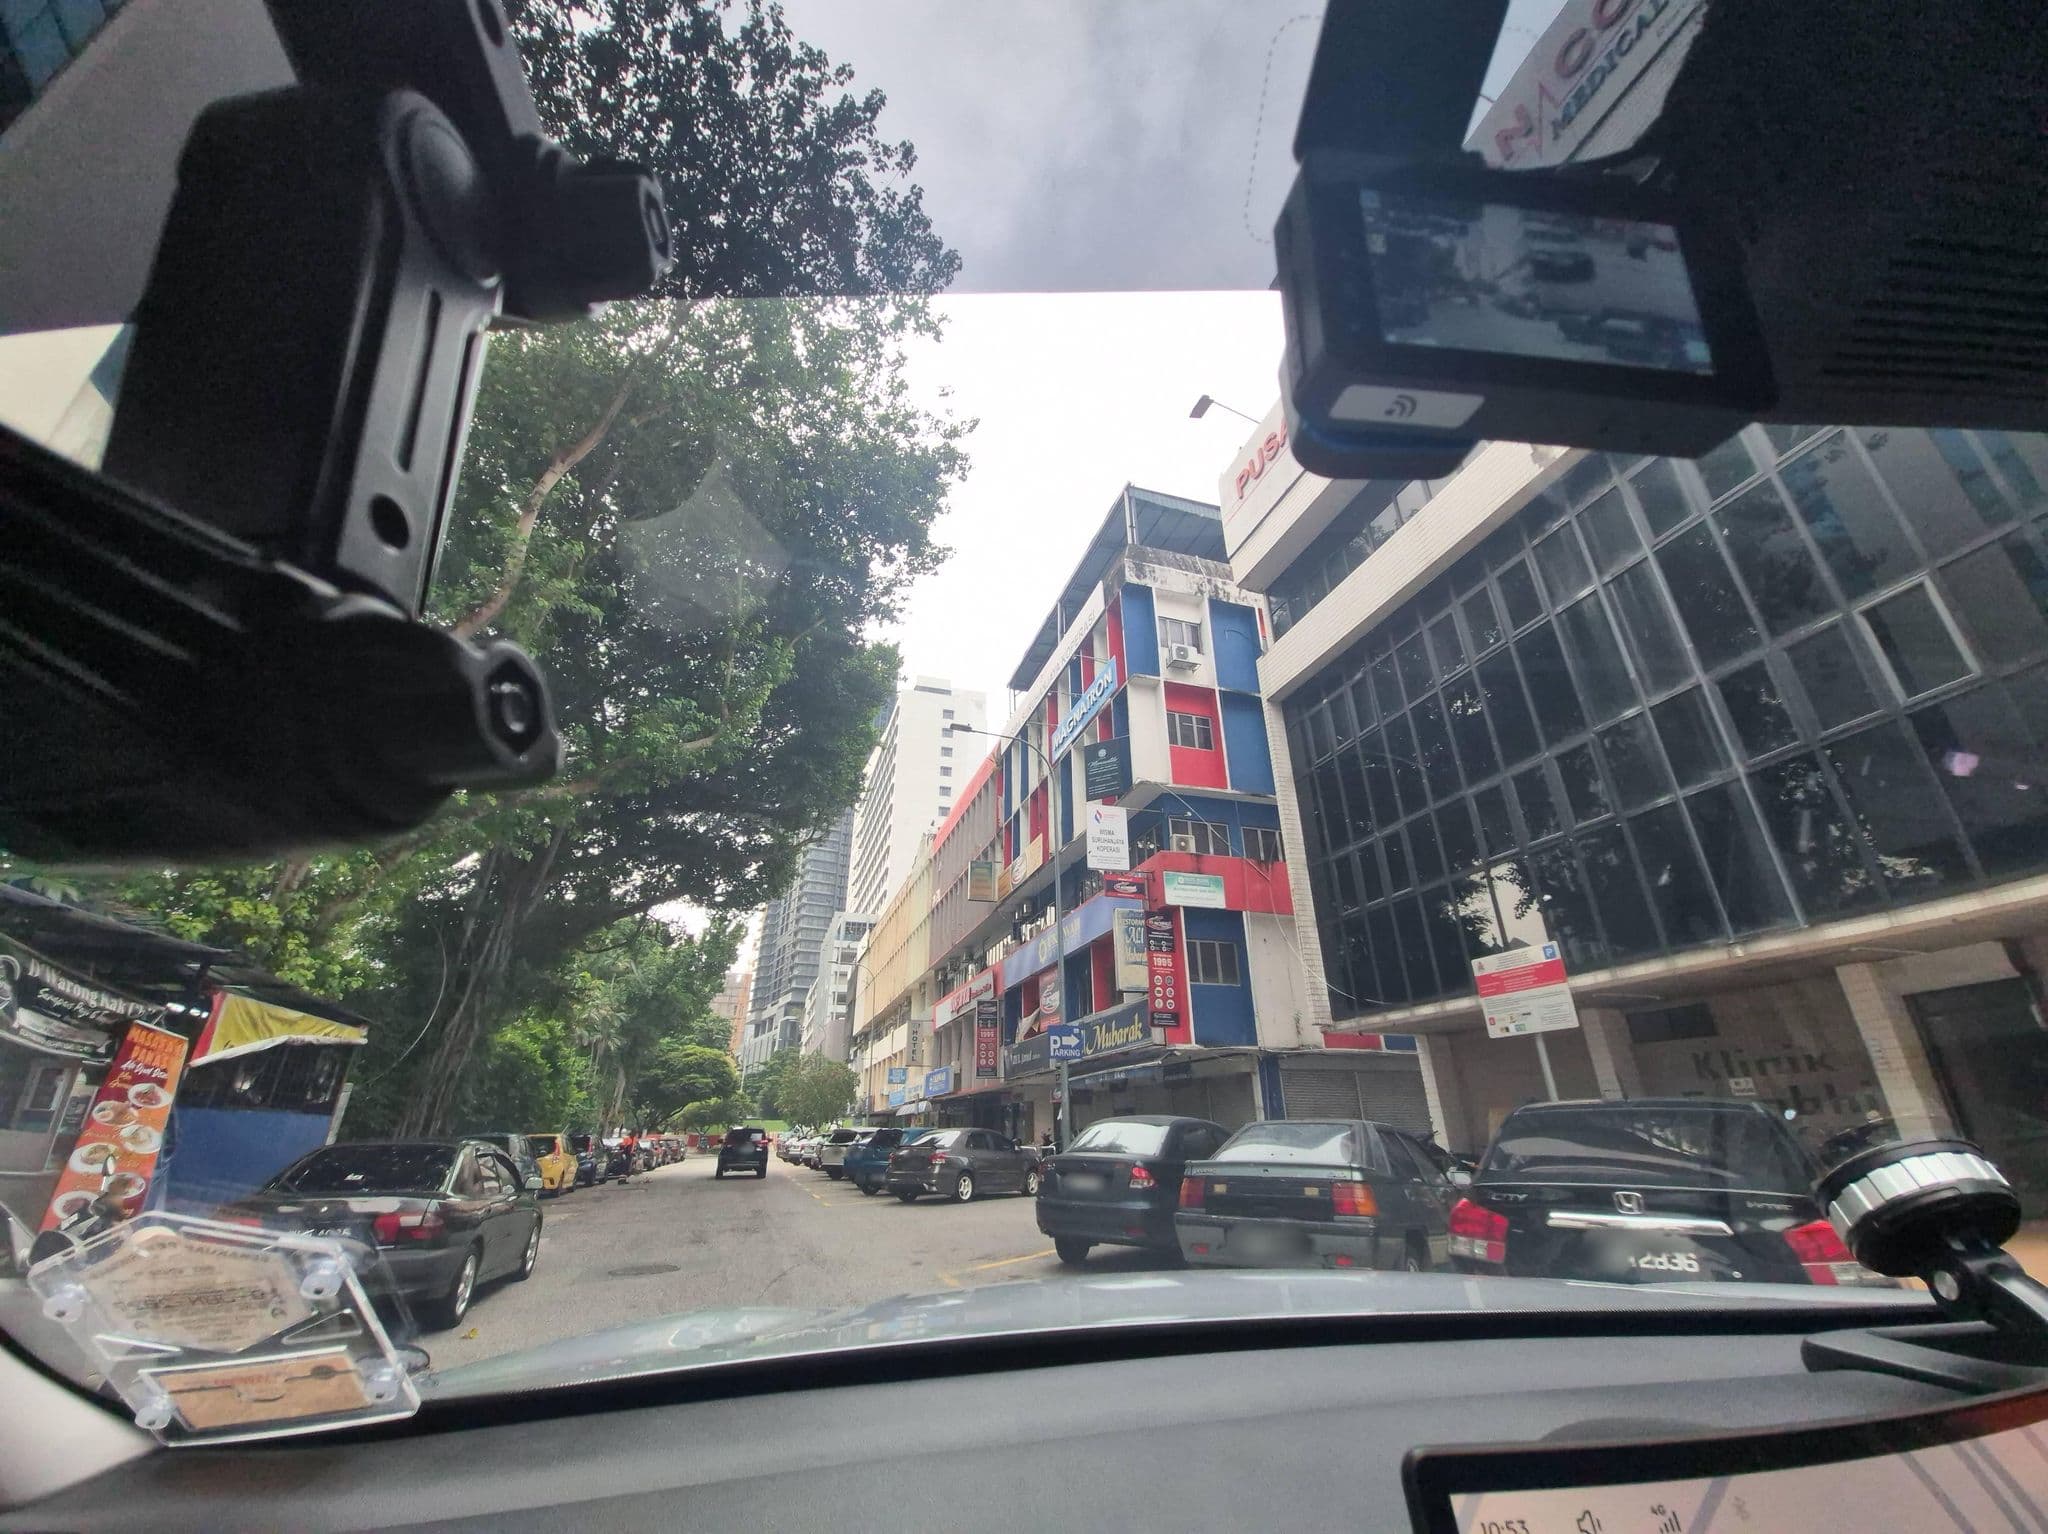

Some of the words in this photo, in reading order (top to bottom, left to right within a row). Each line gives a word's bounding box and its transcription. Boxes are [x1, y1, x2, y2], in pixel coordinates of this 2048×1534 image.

[1054, 666, 1113, 752] MAGNATRON
[1086, 1012, 1144, 1055] Mubarak
[1692, 1047, 1836, 1081] Klinik
